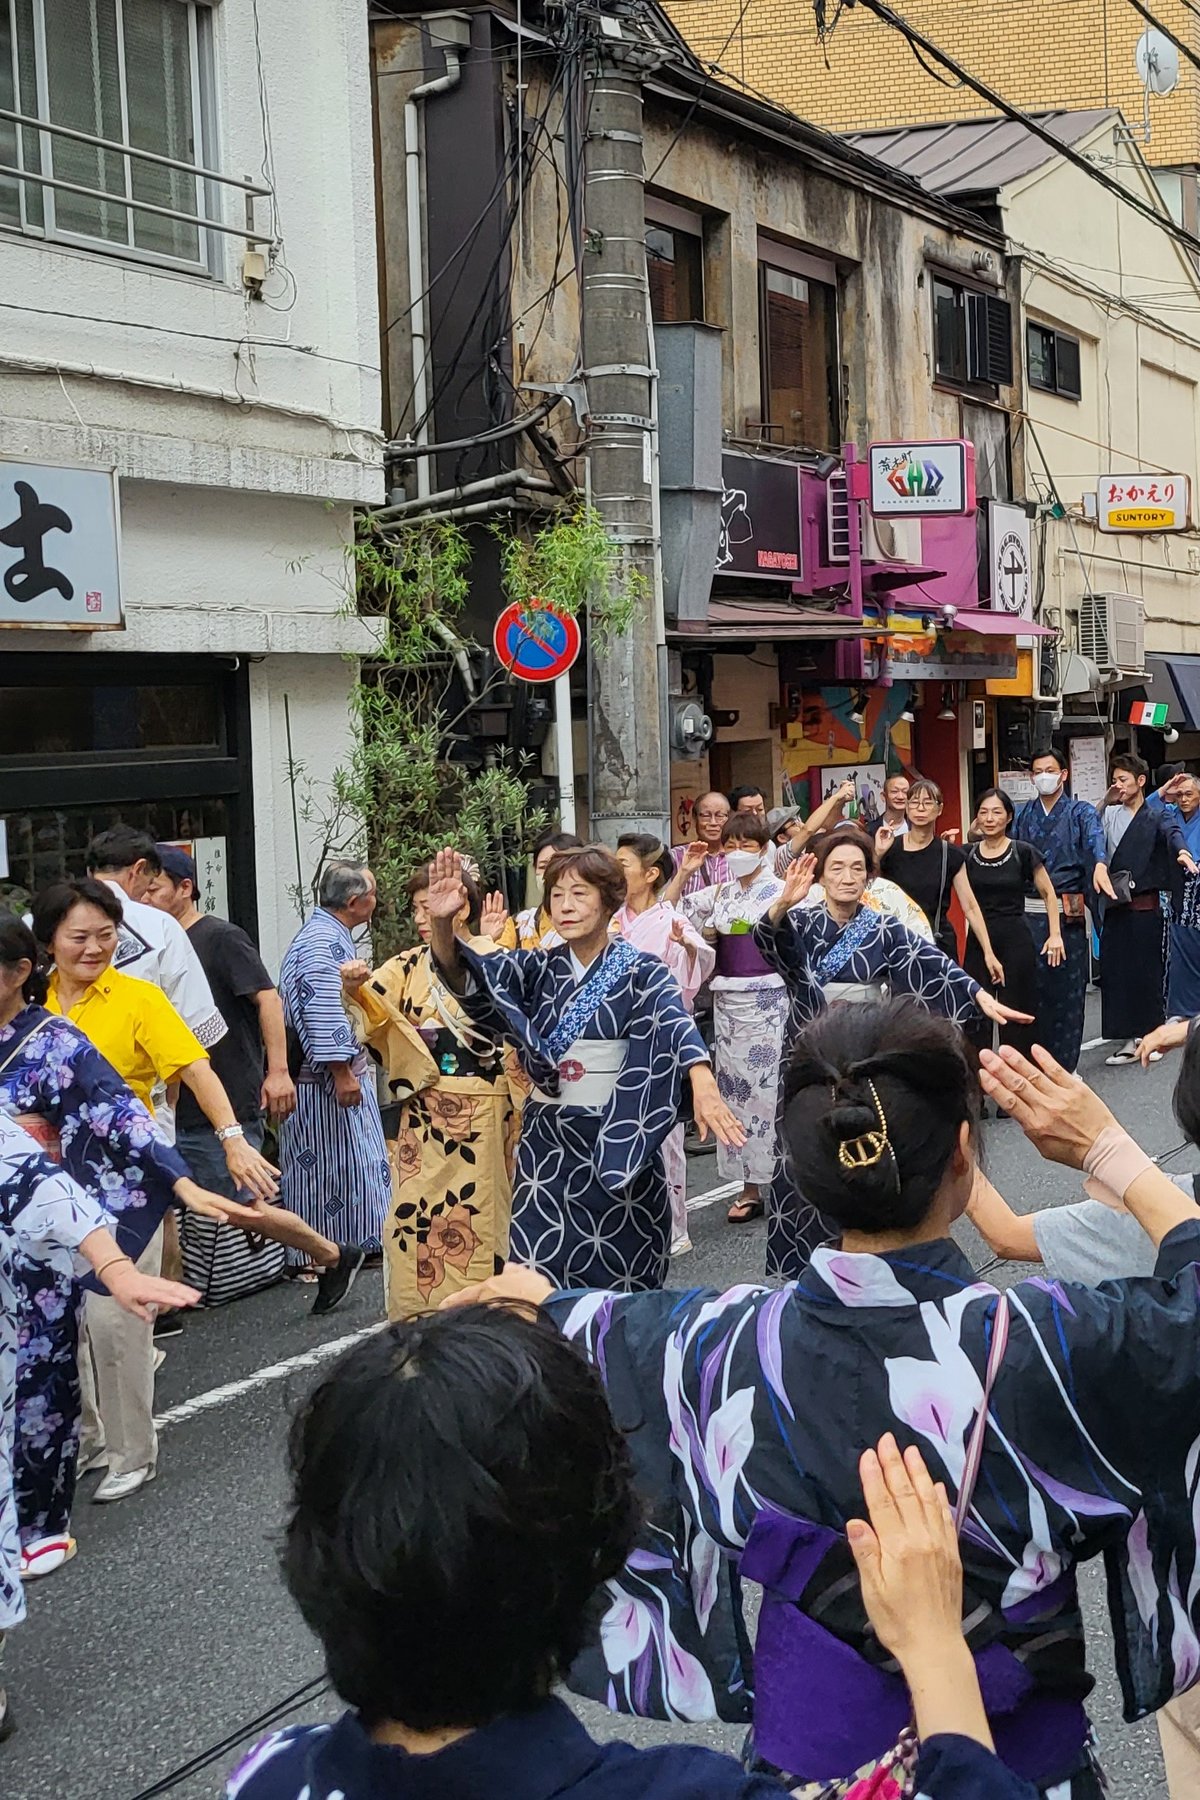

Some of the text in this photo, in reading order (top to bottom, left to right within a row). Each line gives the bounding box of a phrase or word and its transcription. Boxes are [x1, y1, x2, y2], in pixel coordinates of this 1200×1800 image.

[1107, 483, 1175, 504] おかえり
[1116, 513, 1167, 522] SUNTORY
